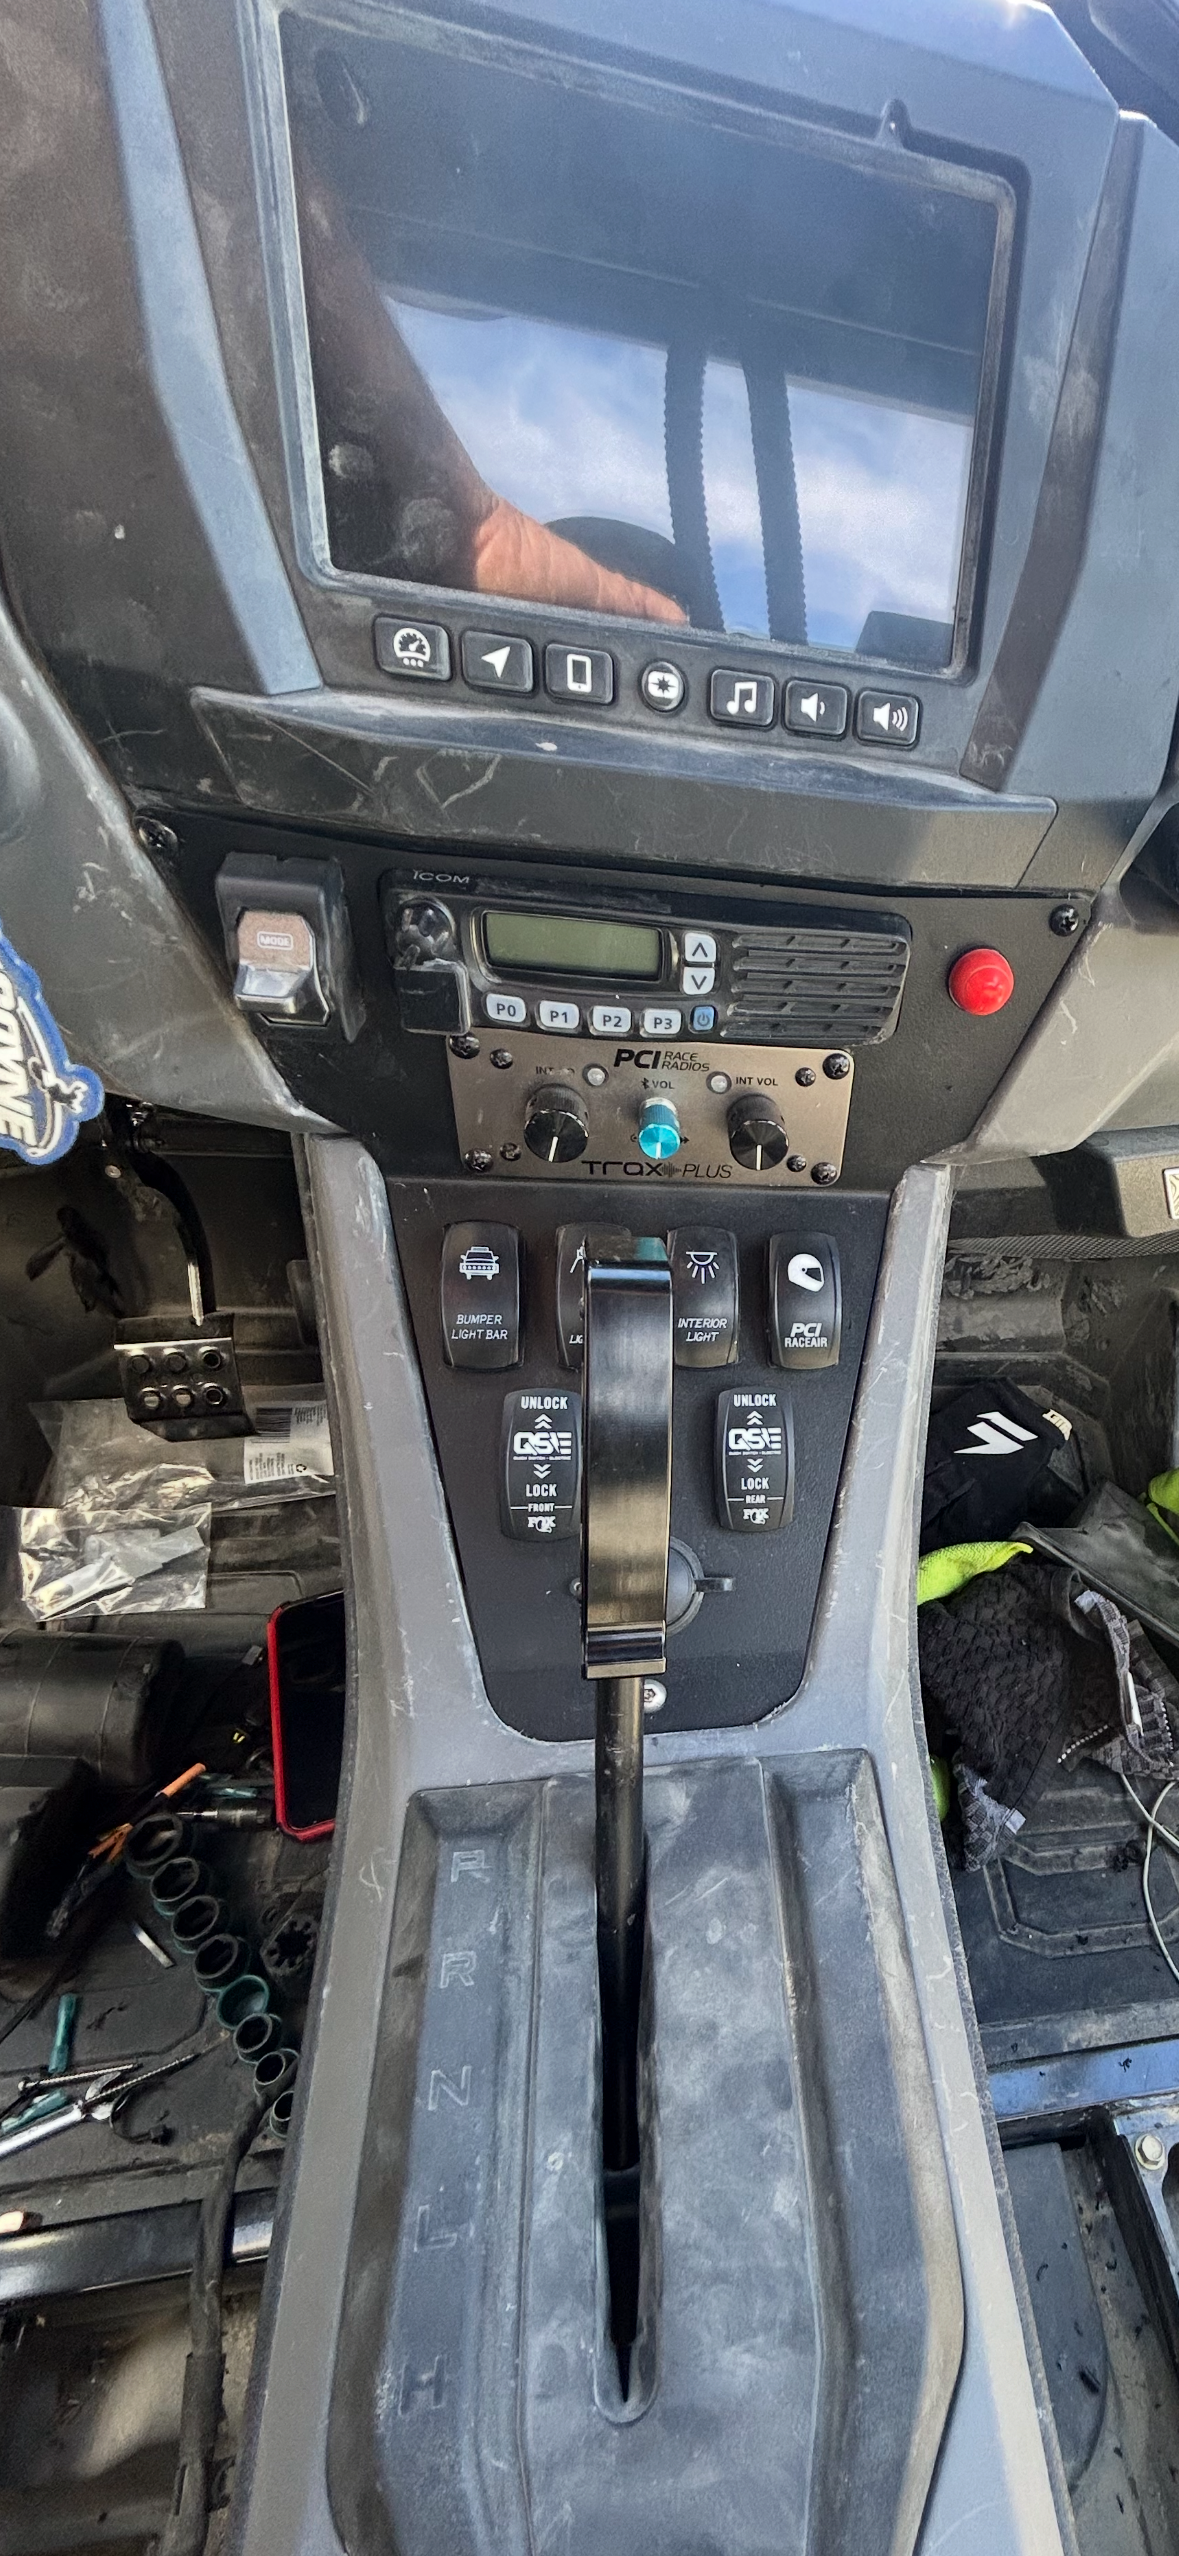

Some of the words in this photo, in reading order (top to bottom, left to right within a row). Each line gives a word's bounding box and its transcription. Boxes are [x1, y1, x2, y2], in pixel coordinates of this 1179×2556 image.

[260, 935, 290, 947] MODE
[496, 1003, 517, 1018] P0
[549, 1011, 569, 1024] P1
[602, 1014, 623, 1028] P2
[653, 1017, 673, 1030] P3
[613, 1048, 662, 1070] PCI
[663, 1051, 699, 1062] RACE
[661, 1060, 711, 1072] RADIOS
[652, 1080, 675, 1090] VOL
[735, 1076, 754, 1086] INT
[756, 1077, 779, 1087] VOL
[681, 1163, 733, 1179] PLUS
[456, 1314, 503, 1325] BUMPER
[677, 1317, 728, 1329] INTERIOR
[451, 1329, 485, 1340] LIGHT
[485, 1329, 509, 1340] BAR
[685, 1331, 720, 1342] LIGHT
[790, 1322, 823, 1338] PCI
[568, 1334, 584, 1344] LIG
[784, 1336, 828, 1348] RACEAIR
[520, 1396, 569, 1410] UNLOCK
[733, 1393, 777, 1407] UNLOCK
[525, 1483, 558, 1497] LOCK
[741, 1477, 770, 1490] LOCK
[745, 1494, 766, 1504] REAR
[527, 1503, 555, 1513] FRONT
[743, 1507, 770, 1525] FOX
[527, 1515, 557, 1534] FOX
[439, 1950, 477, 1989] R
[428, 2065, 472, 2112] N
[413, 2204, 458, 2252] L
